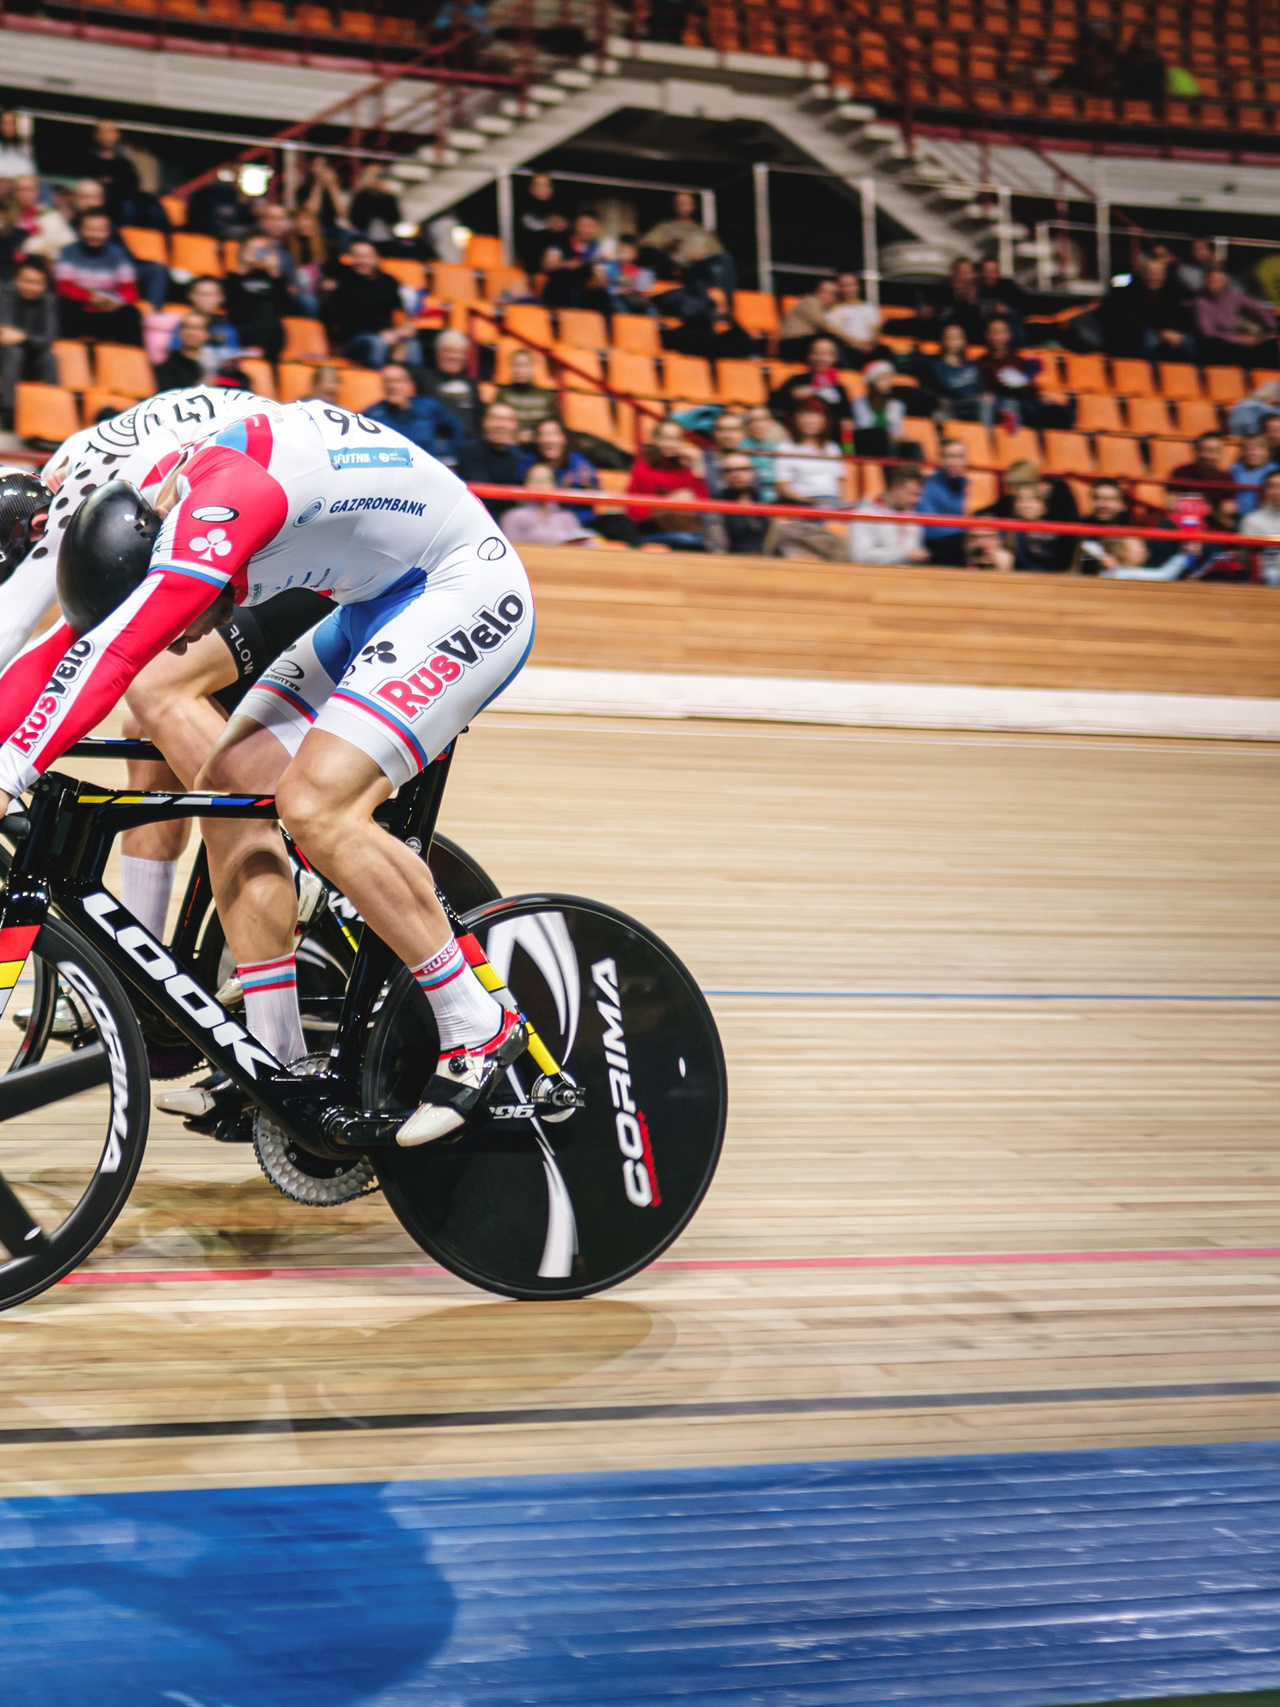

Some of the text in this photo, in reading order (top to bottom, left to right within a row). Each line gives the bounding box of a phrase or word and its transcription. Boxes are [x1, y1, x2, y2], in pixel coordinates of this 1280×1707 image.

[172, 394, 216, 424] 47
[329, 497, 427, 517] GAZPROMBANK
[82, 892, 282, 1081] LOOK
[589, 957, 653, 1208] CORIMA
